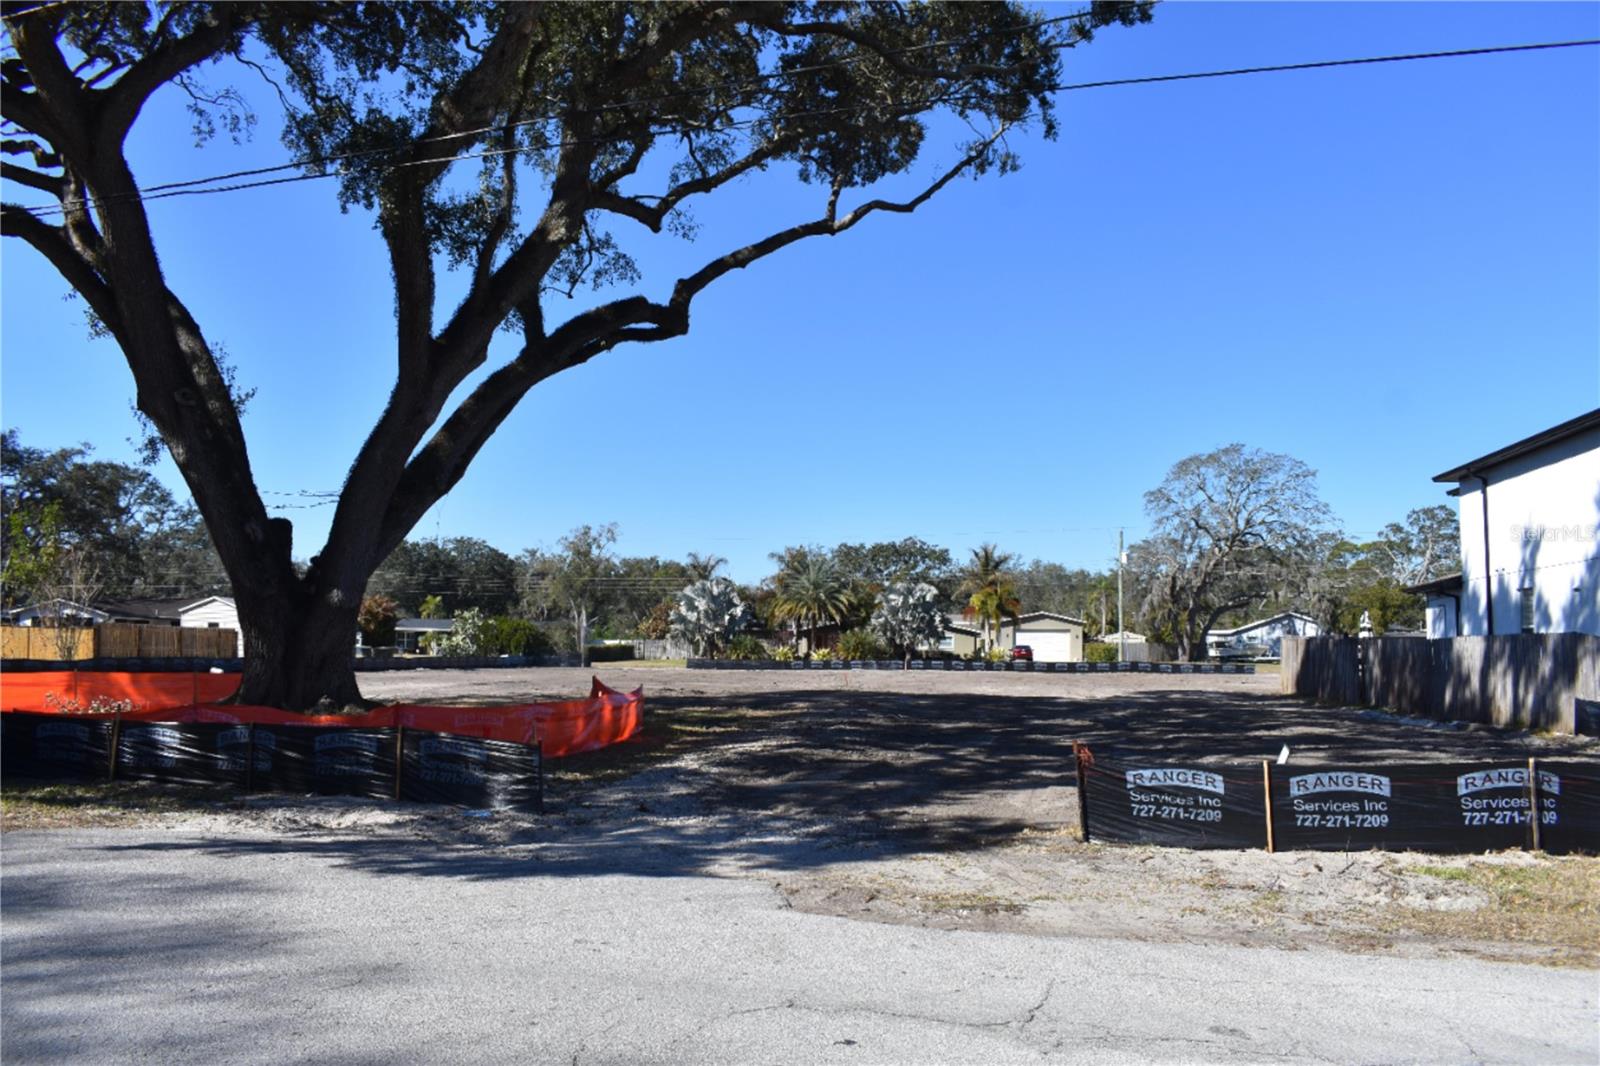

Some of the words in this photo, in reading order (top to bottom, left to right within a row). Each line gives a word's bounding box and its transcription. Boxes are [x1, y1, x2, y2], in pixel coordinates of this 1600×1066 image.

[1132, 770, 1218, 788] RANGER
[1295, 774, 1384, 791] RANGER
[1463, 770, 1553, 789] RANGR
[1130, 790, 1195, 806] Services
[1199, 795, 1222, 808] Inc
[1293, 799, 1360, 812] Services
[1364, 799, 1388, 811] Inc
[1460, 796, 1530, 810] Services
[1131, 804, 1223, 822] 727-271-7209
[1295, 814, 1390, 828] 727-271-7209
[1462, 811, 1557, 825] 727-271-709
